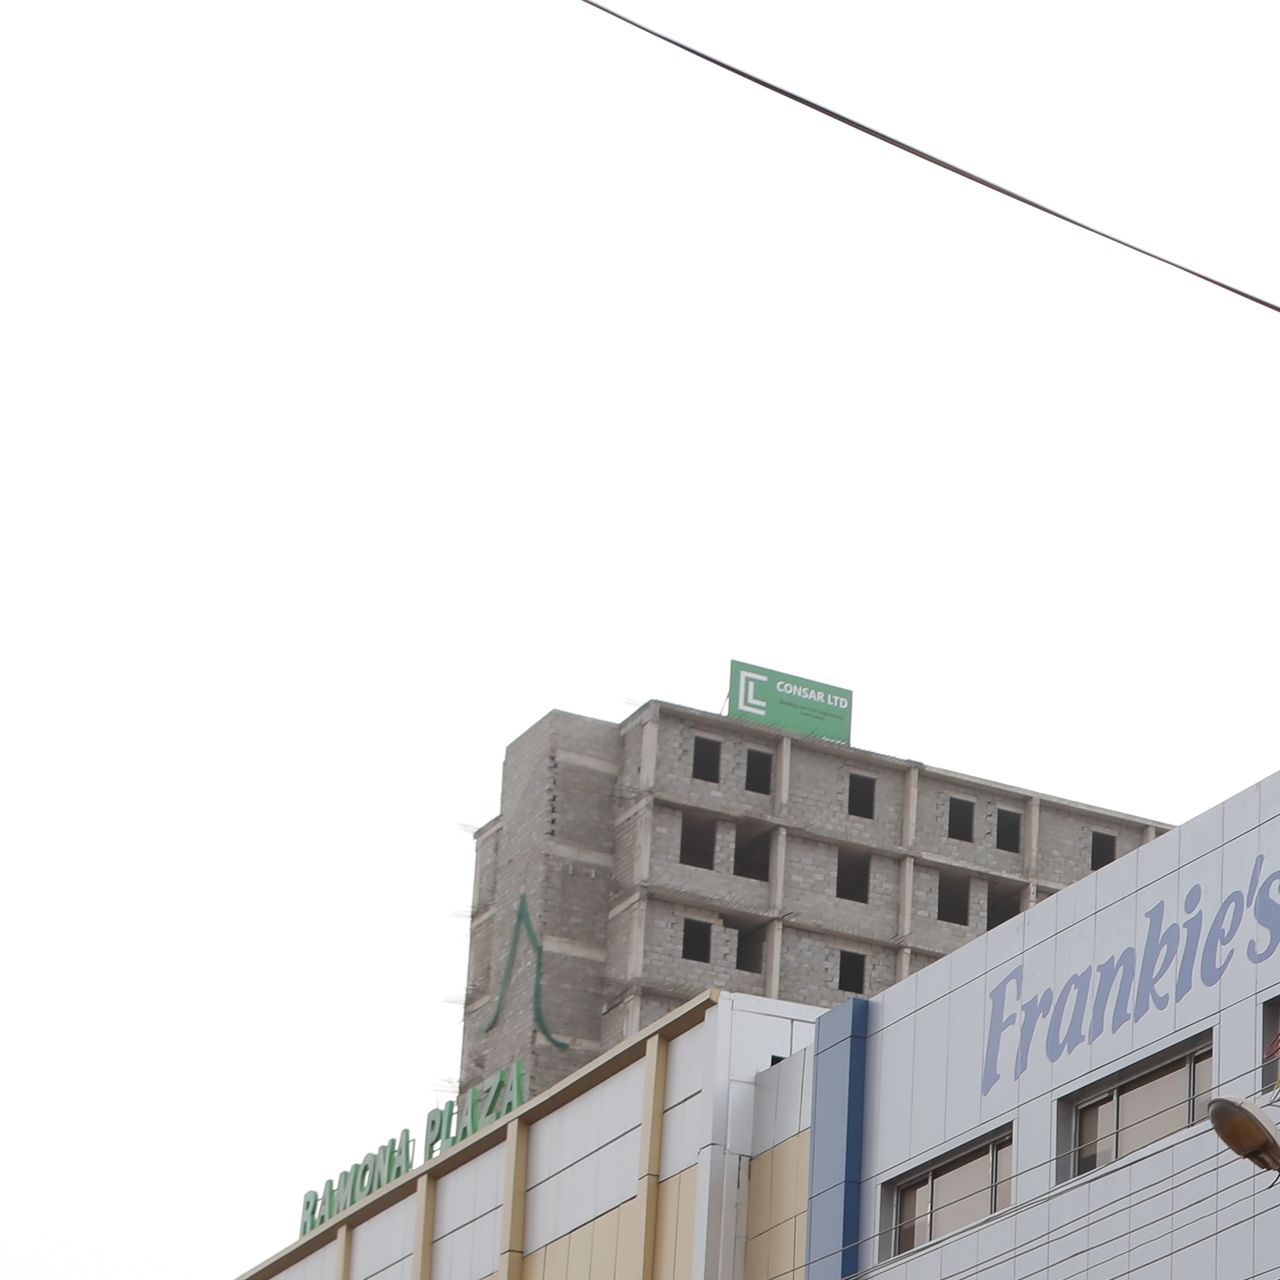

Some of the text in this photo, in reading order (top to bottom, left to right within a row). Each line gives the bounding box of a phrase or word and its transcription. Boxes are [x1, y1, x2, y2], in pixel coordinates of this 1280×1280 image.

[776, 681, 849, 709] CONSAR LTD
[301, 1060, 526, 1237] RAMONA PLAZA
